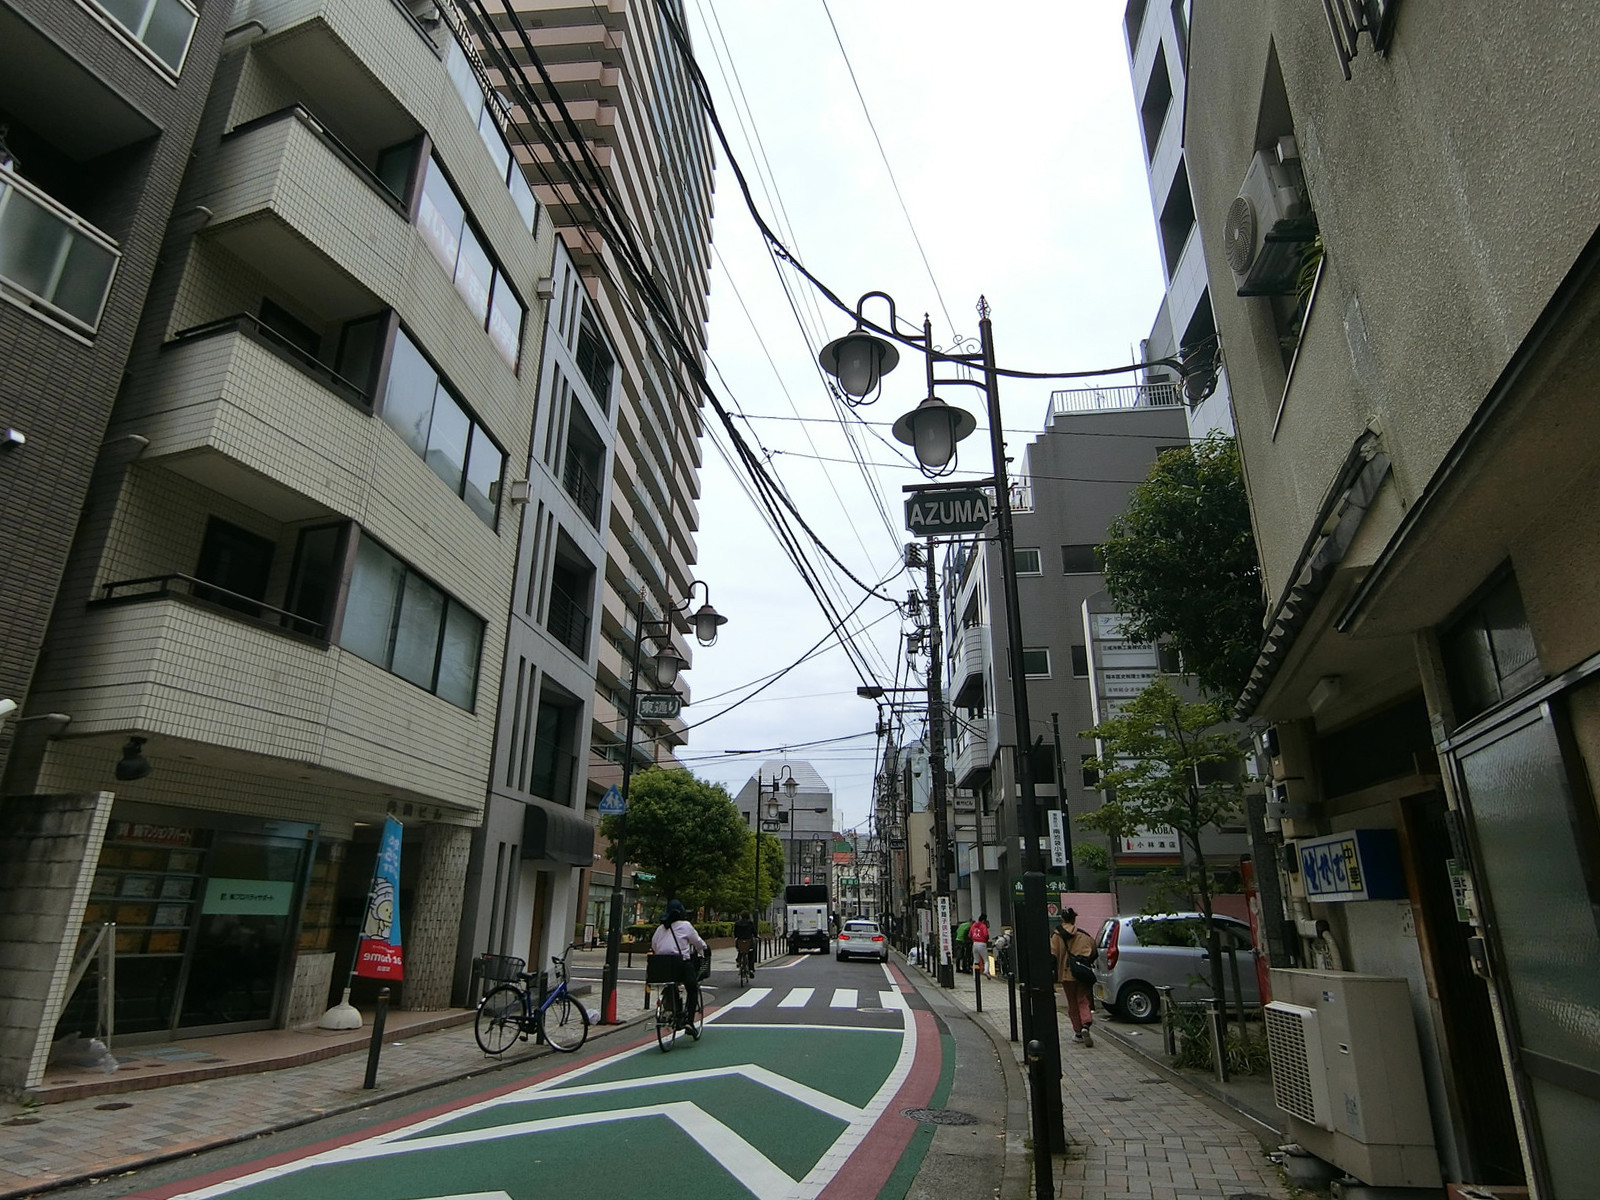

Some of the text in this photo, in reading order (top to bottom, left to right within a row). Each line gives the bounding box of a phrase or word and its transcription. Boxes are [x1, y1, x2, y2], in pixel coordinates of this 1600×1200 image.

[909, 498, 988, 526] AZUMA
[640, 700, 679, 714] 東通り
[1053, 829, 1063, 863] 南池袋小学校
[1343, 845, 1360, 886] 中華
